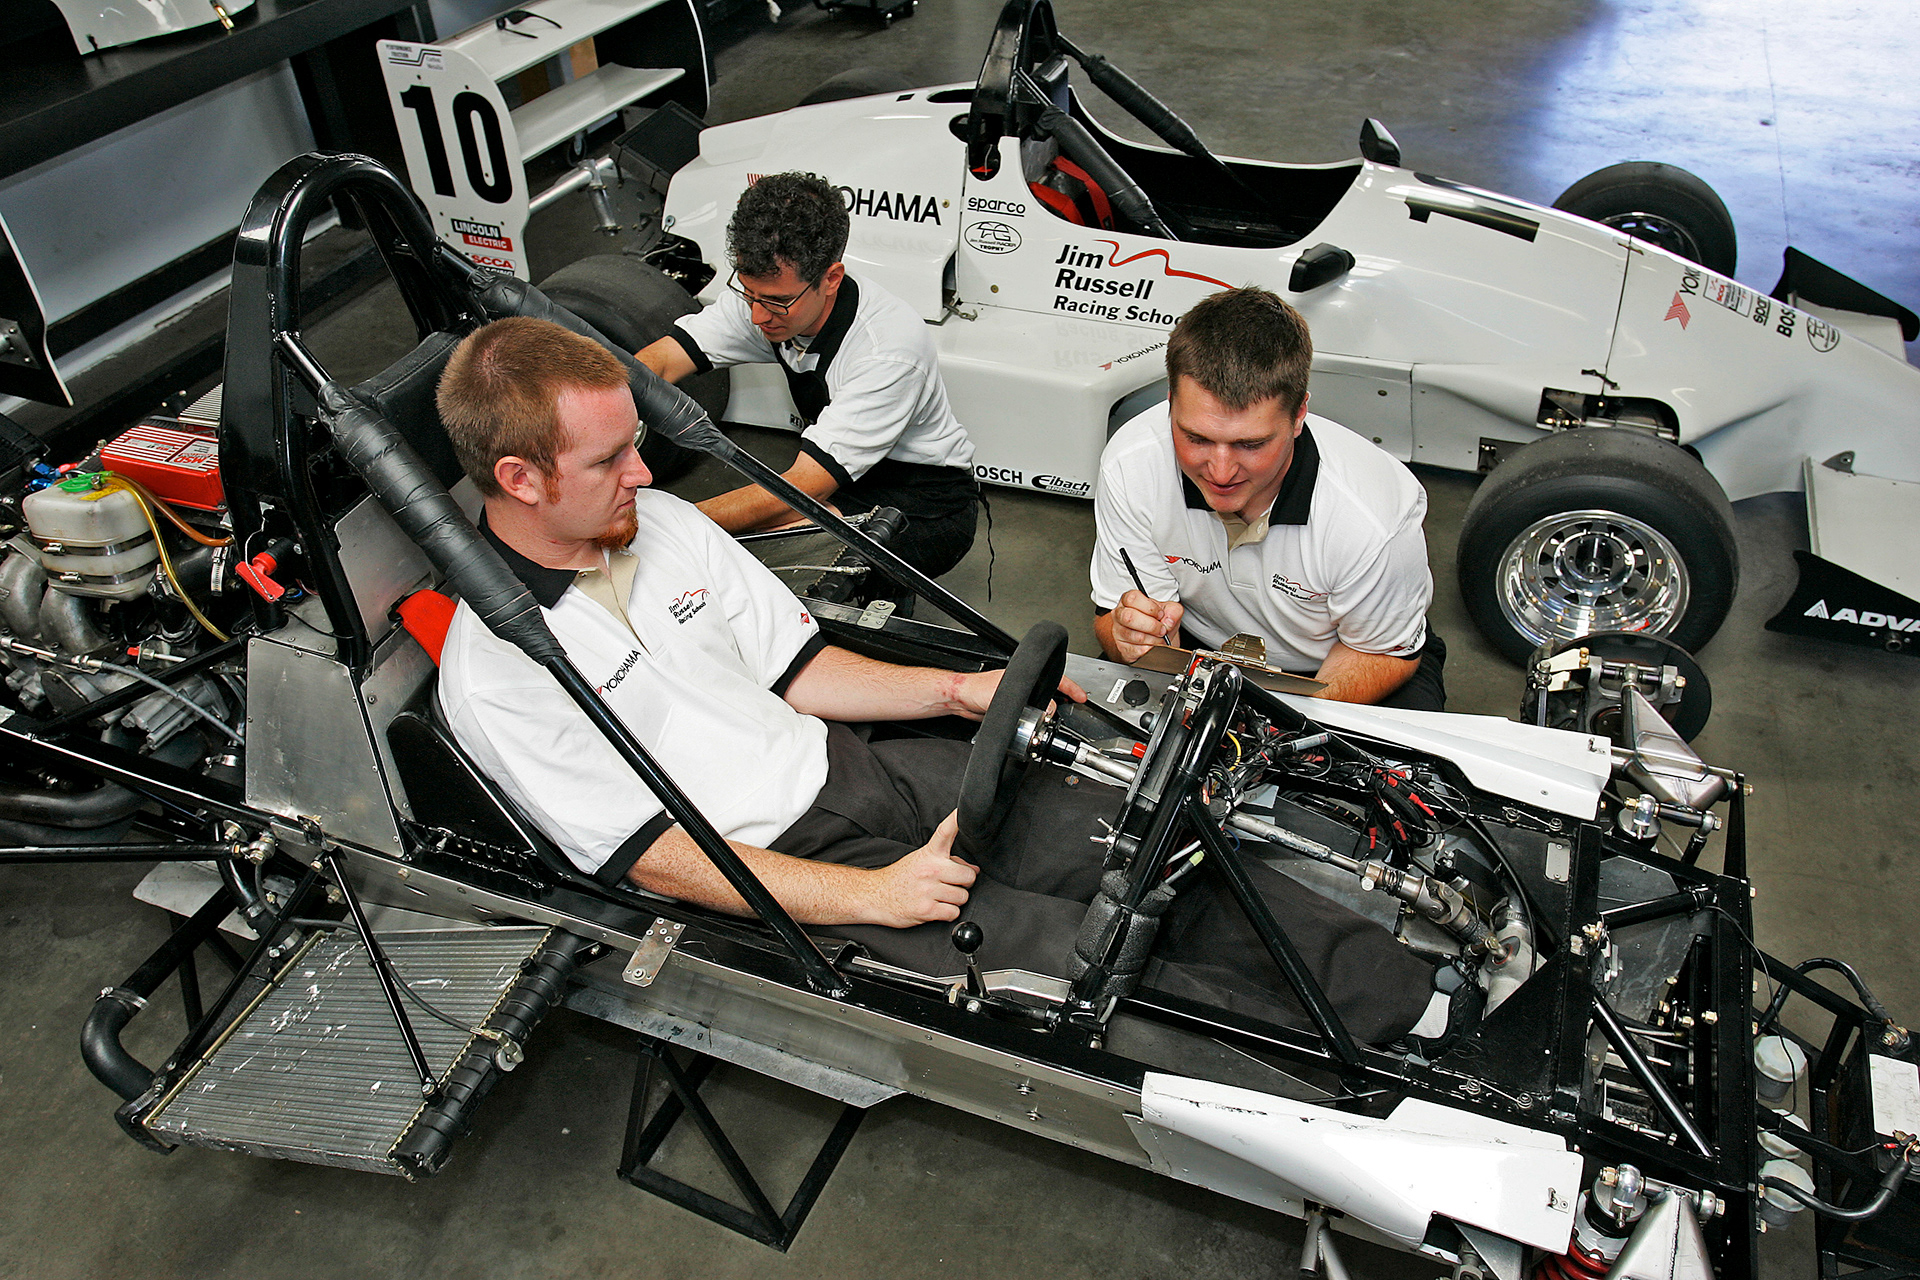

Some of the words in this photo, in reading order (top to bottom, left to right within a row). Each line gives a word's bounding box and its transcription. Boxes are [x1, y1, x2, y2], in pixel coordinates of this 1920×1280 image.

[399, 84, 513, 204] 10
[968, 197, 1026, 214] sparco
[454, 220, 499, 238] LINCOLN
[468, 235, 507, 249] ELECTRIC
[471, 254, 514, 269] SCCA
[1055, 244, 1104, 269] Jim
[1054, 268, 1154, 300] Russell
[1053, 295, 1121, 321] Racing
[1114, 342, 1167, 364] YOKOHAMA
[173, 456, 207, 464] MSD
[975, 465, 1023, 485] OSCH
[1031, 475, 1091, 492] Eibach
[1272, 573, 1285, 582] Jim
[1272, 579, 1297, 592] Russell
[668, 603, 680, 613] Jim
[673, 599, 694, 619] Russell
[602, 649, 642, 693] YOKOHAMA
